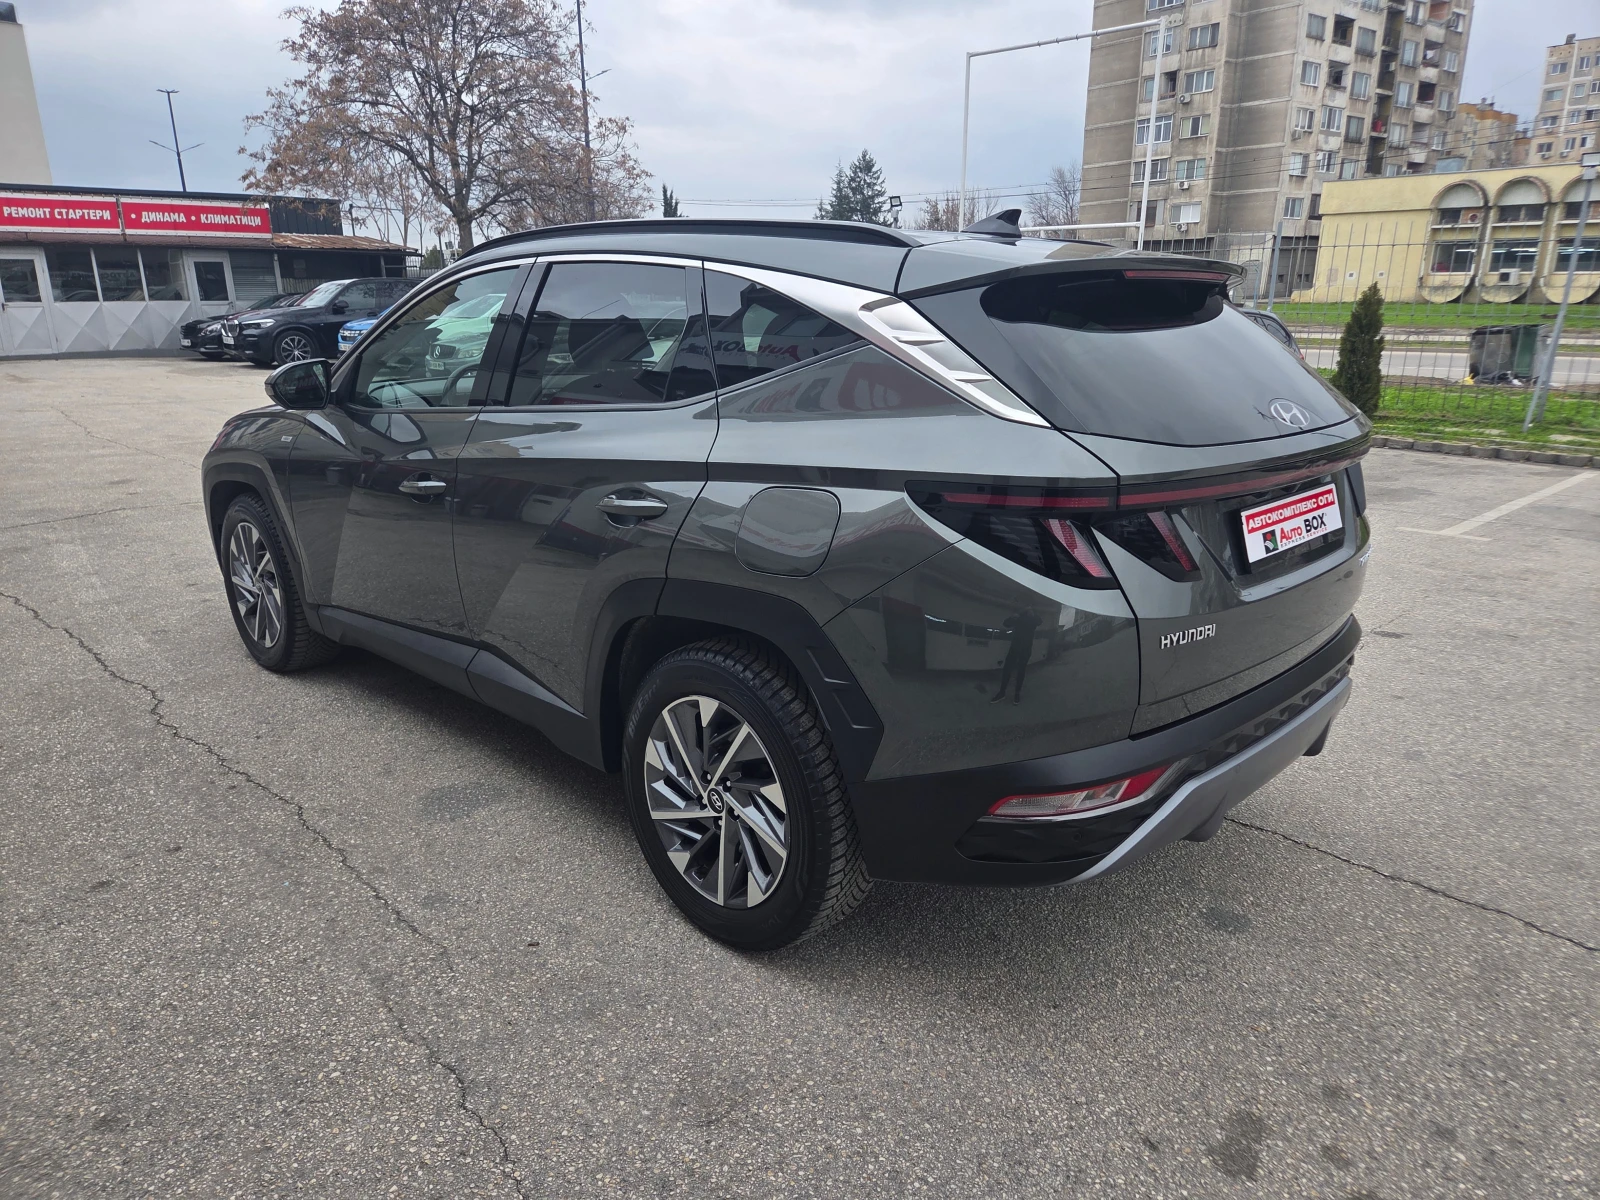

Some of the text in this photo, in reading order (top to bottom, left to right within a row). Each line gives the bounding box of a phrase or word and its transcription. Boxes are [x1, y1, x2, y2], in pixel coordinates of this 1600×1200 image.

[3, 206, 111, 220] РЕМОНТ СТАРТЕРИ
[141, 211, 261, 226] ДИНАМА КЛИМАТИЦИ
[1248, 493, 1334, 530] АВТОКОМПЛЕКС ОГИ
[1304, 513, 1327, 533] BOX
[1281, 527, 1328, 548] EXPRESS SERVICE
[1161, 623, 1216, 650] HYUNDAI
